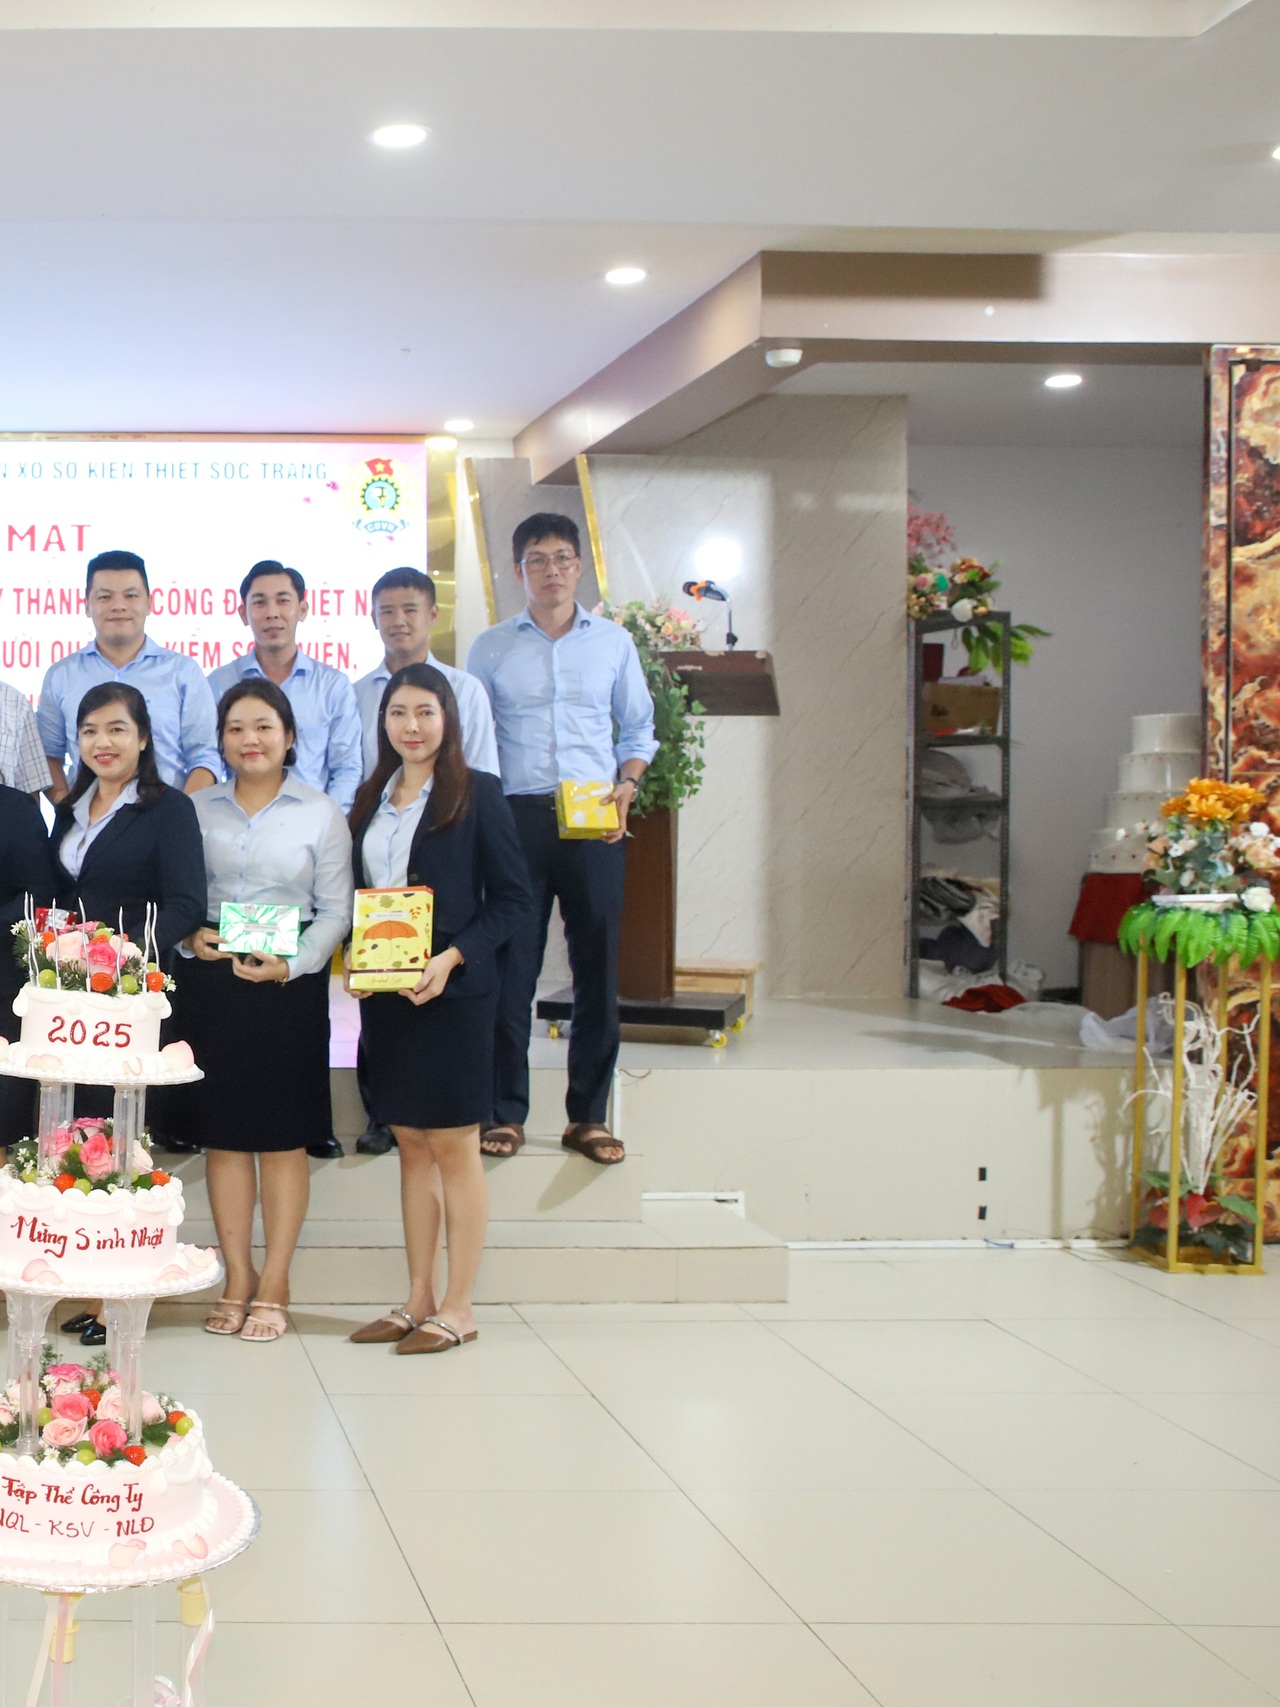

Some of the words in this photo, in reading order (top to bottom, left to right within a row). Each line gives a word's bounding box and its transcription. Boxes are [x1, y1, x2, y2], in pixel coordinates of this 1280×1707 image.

[151, 580, 214, 615] CÔNG
[47, 1015, 132, 1048] 2025
[131, 1226, 164, 1249] Nhật
[1, 1475, 38, 1505] Tập
[41, 1483, 75, 1505] Thể
[81, 1483, 121, 1513] Công
[123, 1483, 143, 1512] Ty
[48, 1519, 95, 1538] KSV
